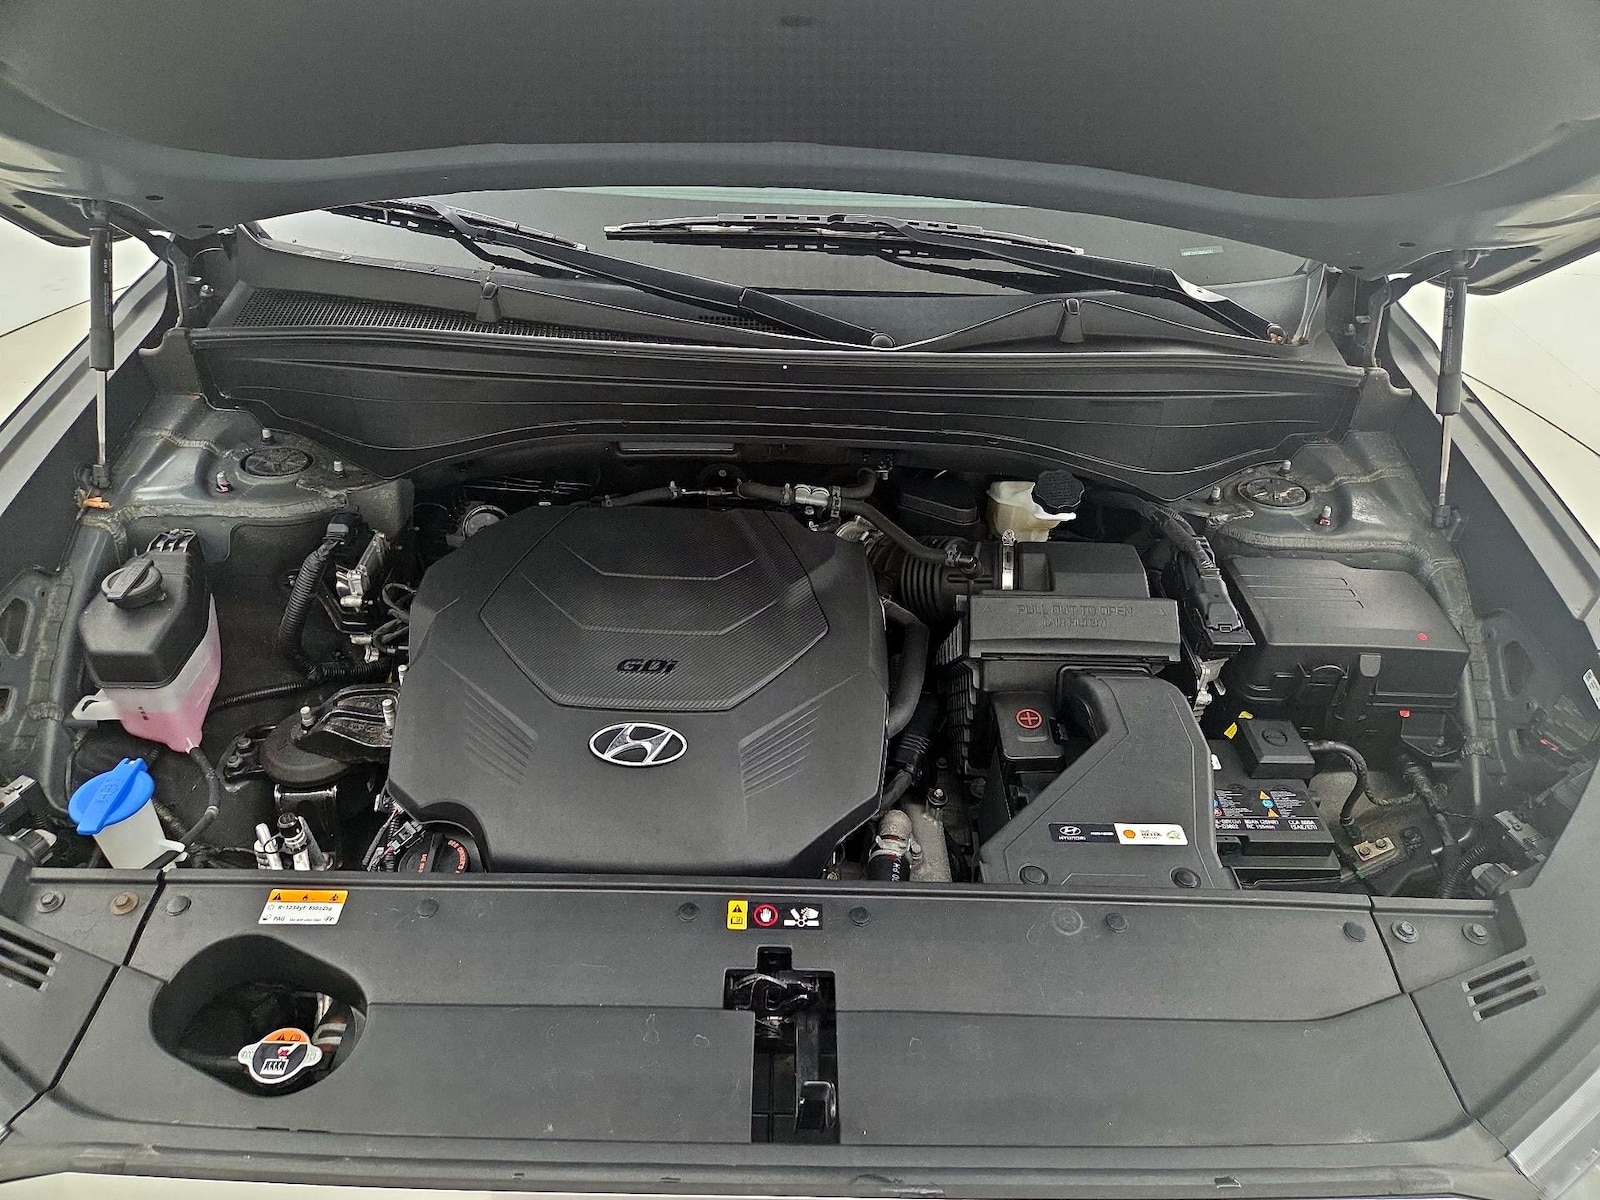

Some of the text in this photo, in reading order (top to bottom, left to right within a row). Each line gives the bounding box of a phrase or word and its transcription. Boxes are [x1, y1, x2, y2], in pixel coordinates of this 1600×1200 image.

[1016, 604, 1133, 617] PULL OUT TO OPEN
